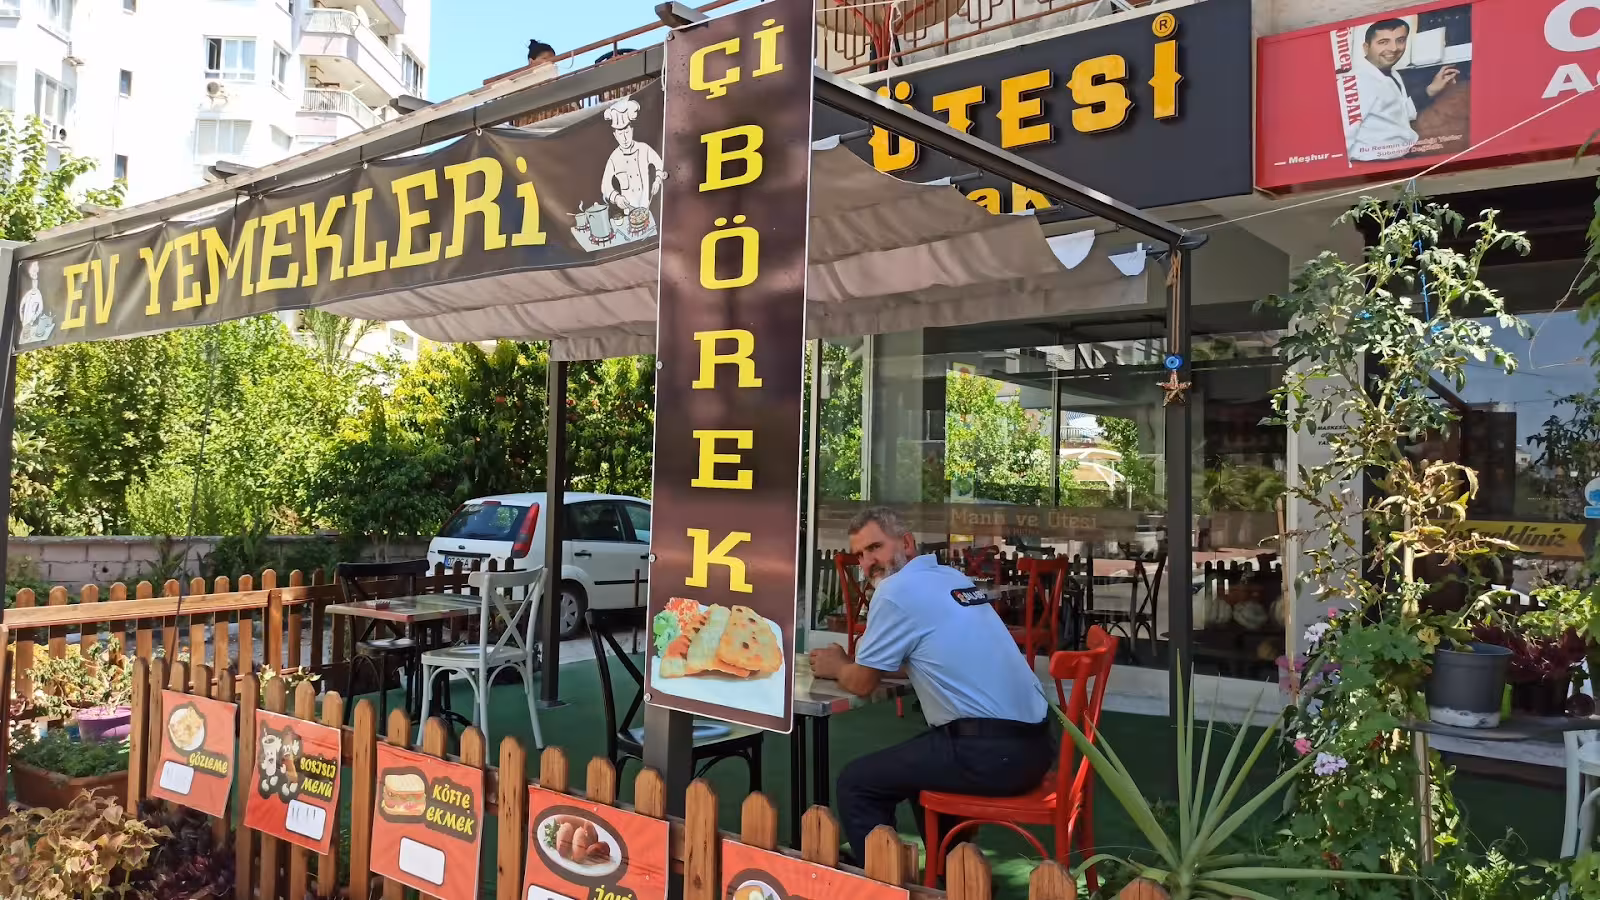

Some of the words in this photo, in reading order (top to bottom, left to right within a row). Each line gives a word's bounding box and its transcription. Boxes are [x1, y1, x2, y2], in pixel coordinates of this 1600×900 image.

[1342, 75, 1363, 125] AYBAK
[1288, 153, 1330, 164] Meşhur
[60, 253, 119, 331] EV
[1015, 513, 1039, 527] ve
[189, 752, 228, 775] GÖZLEME
[300, 777, 334, 798] MENÜ
[432, 784, 471, 809] KÖFTE
[426, 806, 475, 836] EKMEK
